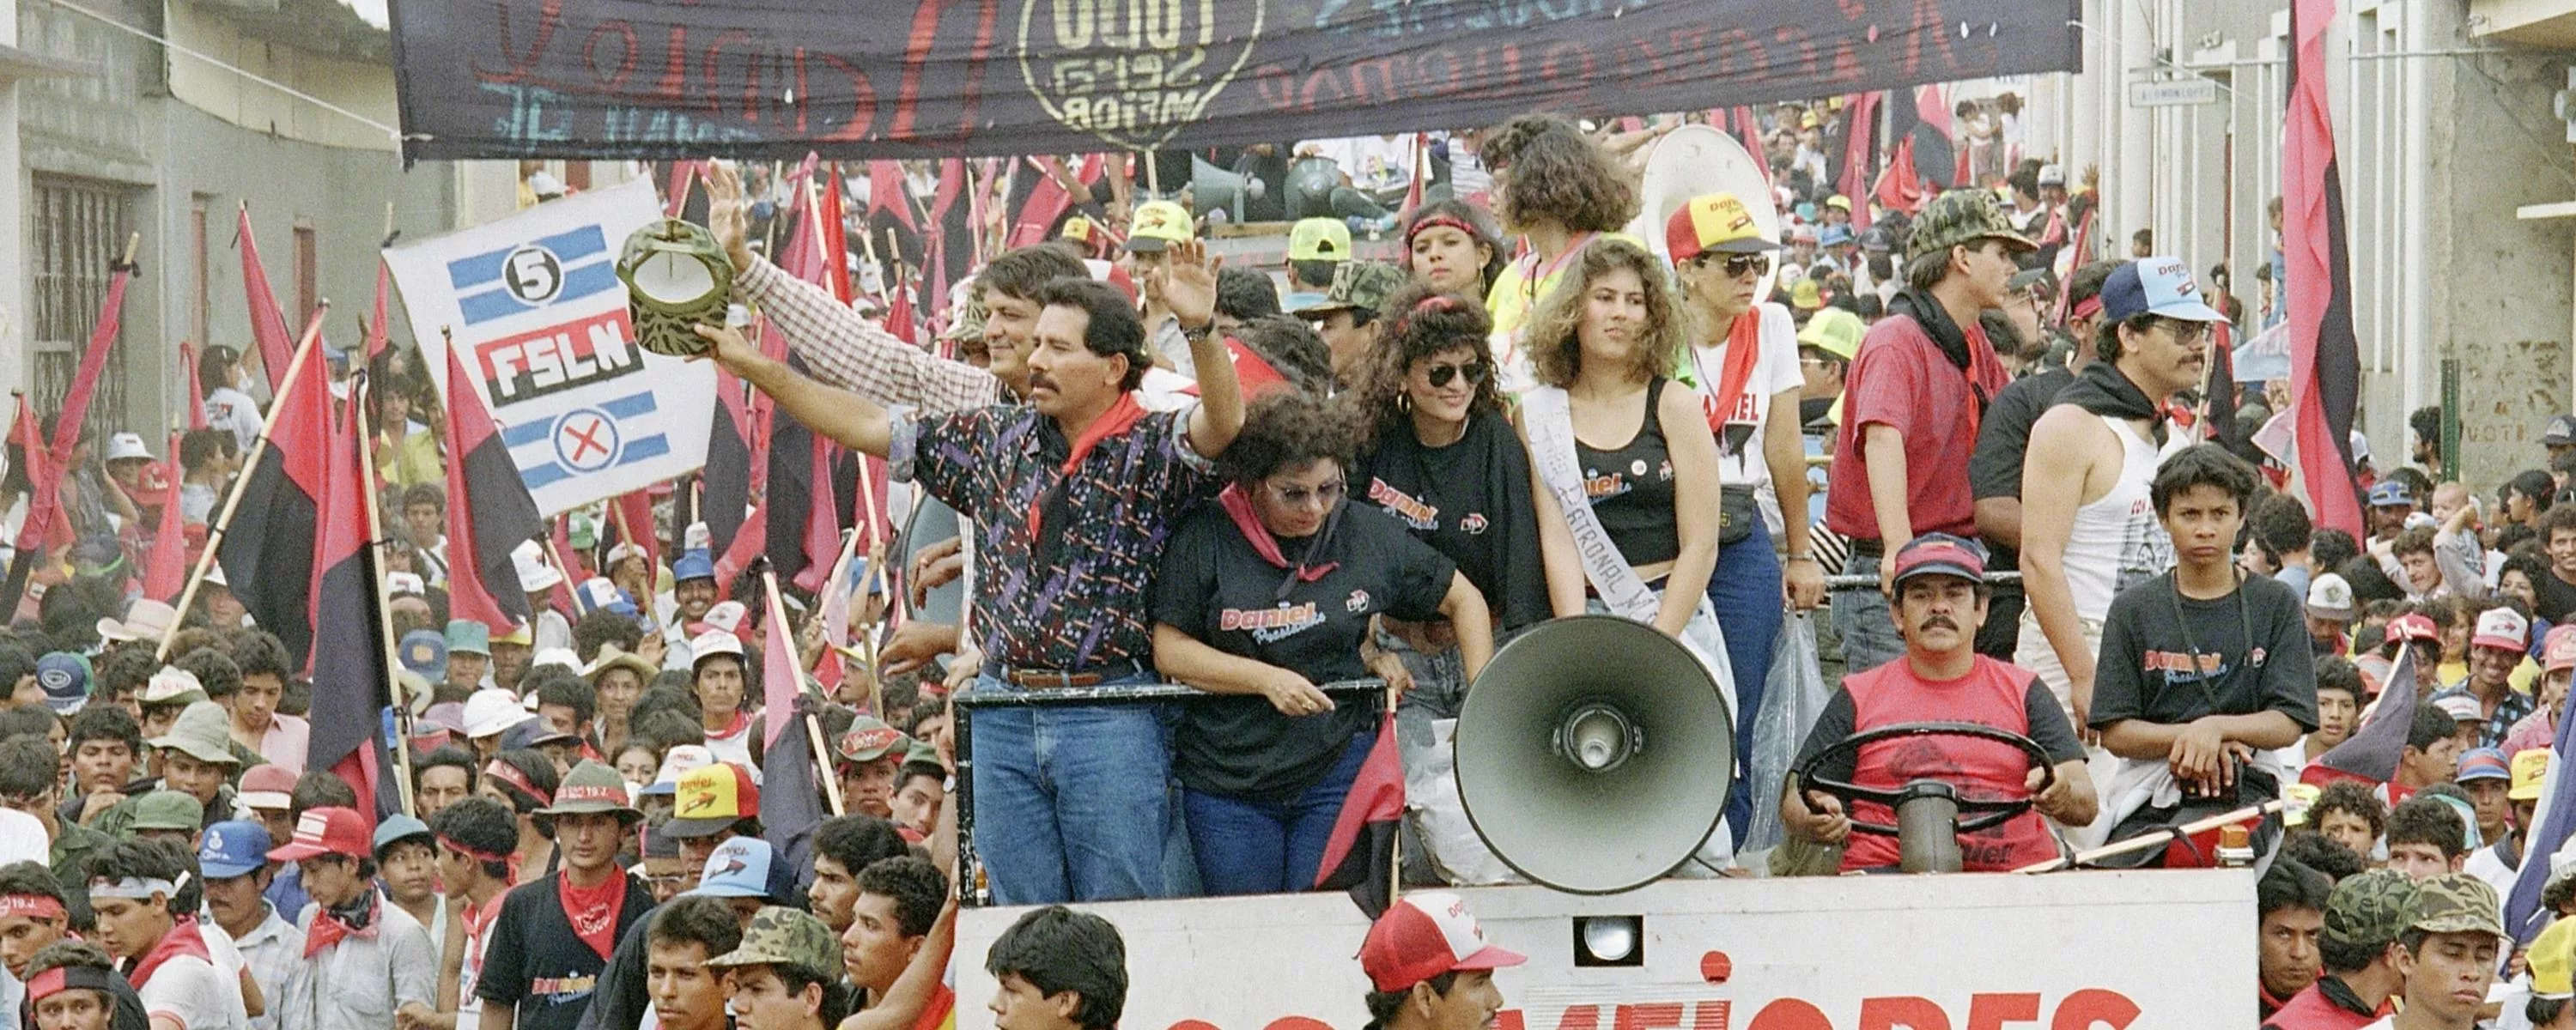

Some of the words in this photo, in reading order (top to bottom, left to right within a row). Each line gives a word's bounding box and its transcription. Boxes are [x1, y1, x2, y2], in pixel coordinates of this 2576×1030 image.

[514, 251, 553, 300] 5
[489, 319, 631, 397] FSLN
[1368, 476, 1439, 524] Daniel
[1556, 477, 1619, 595] PATRONAL
[1220, 602, 1316, 632] Daniel
[2143, 647, 2222, 674] Danel
